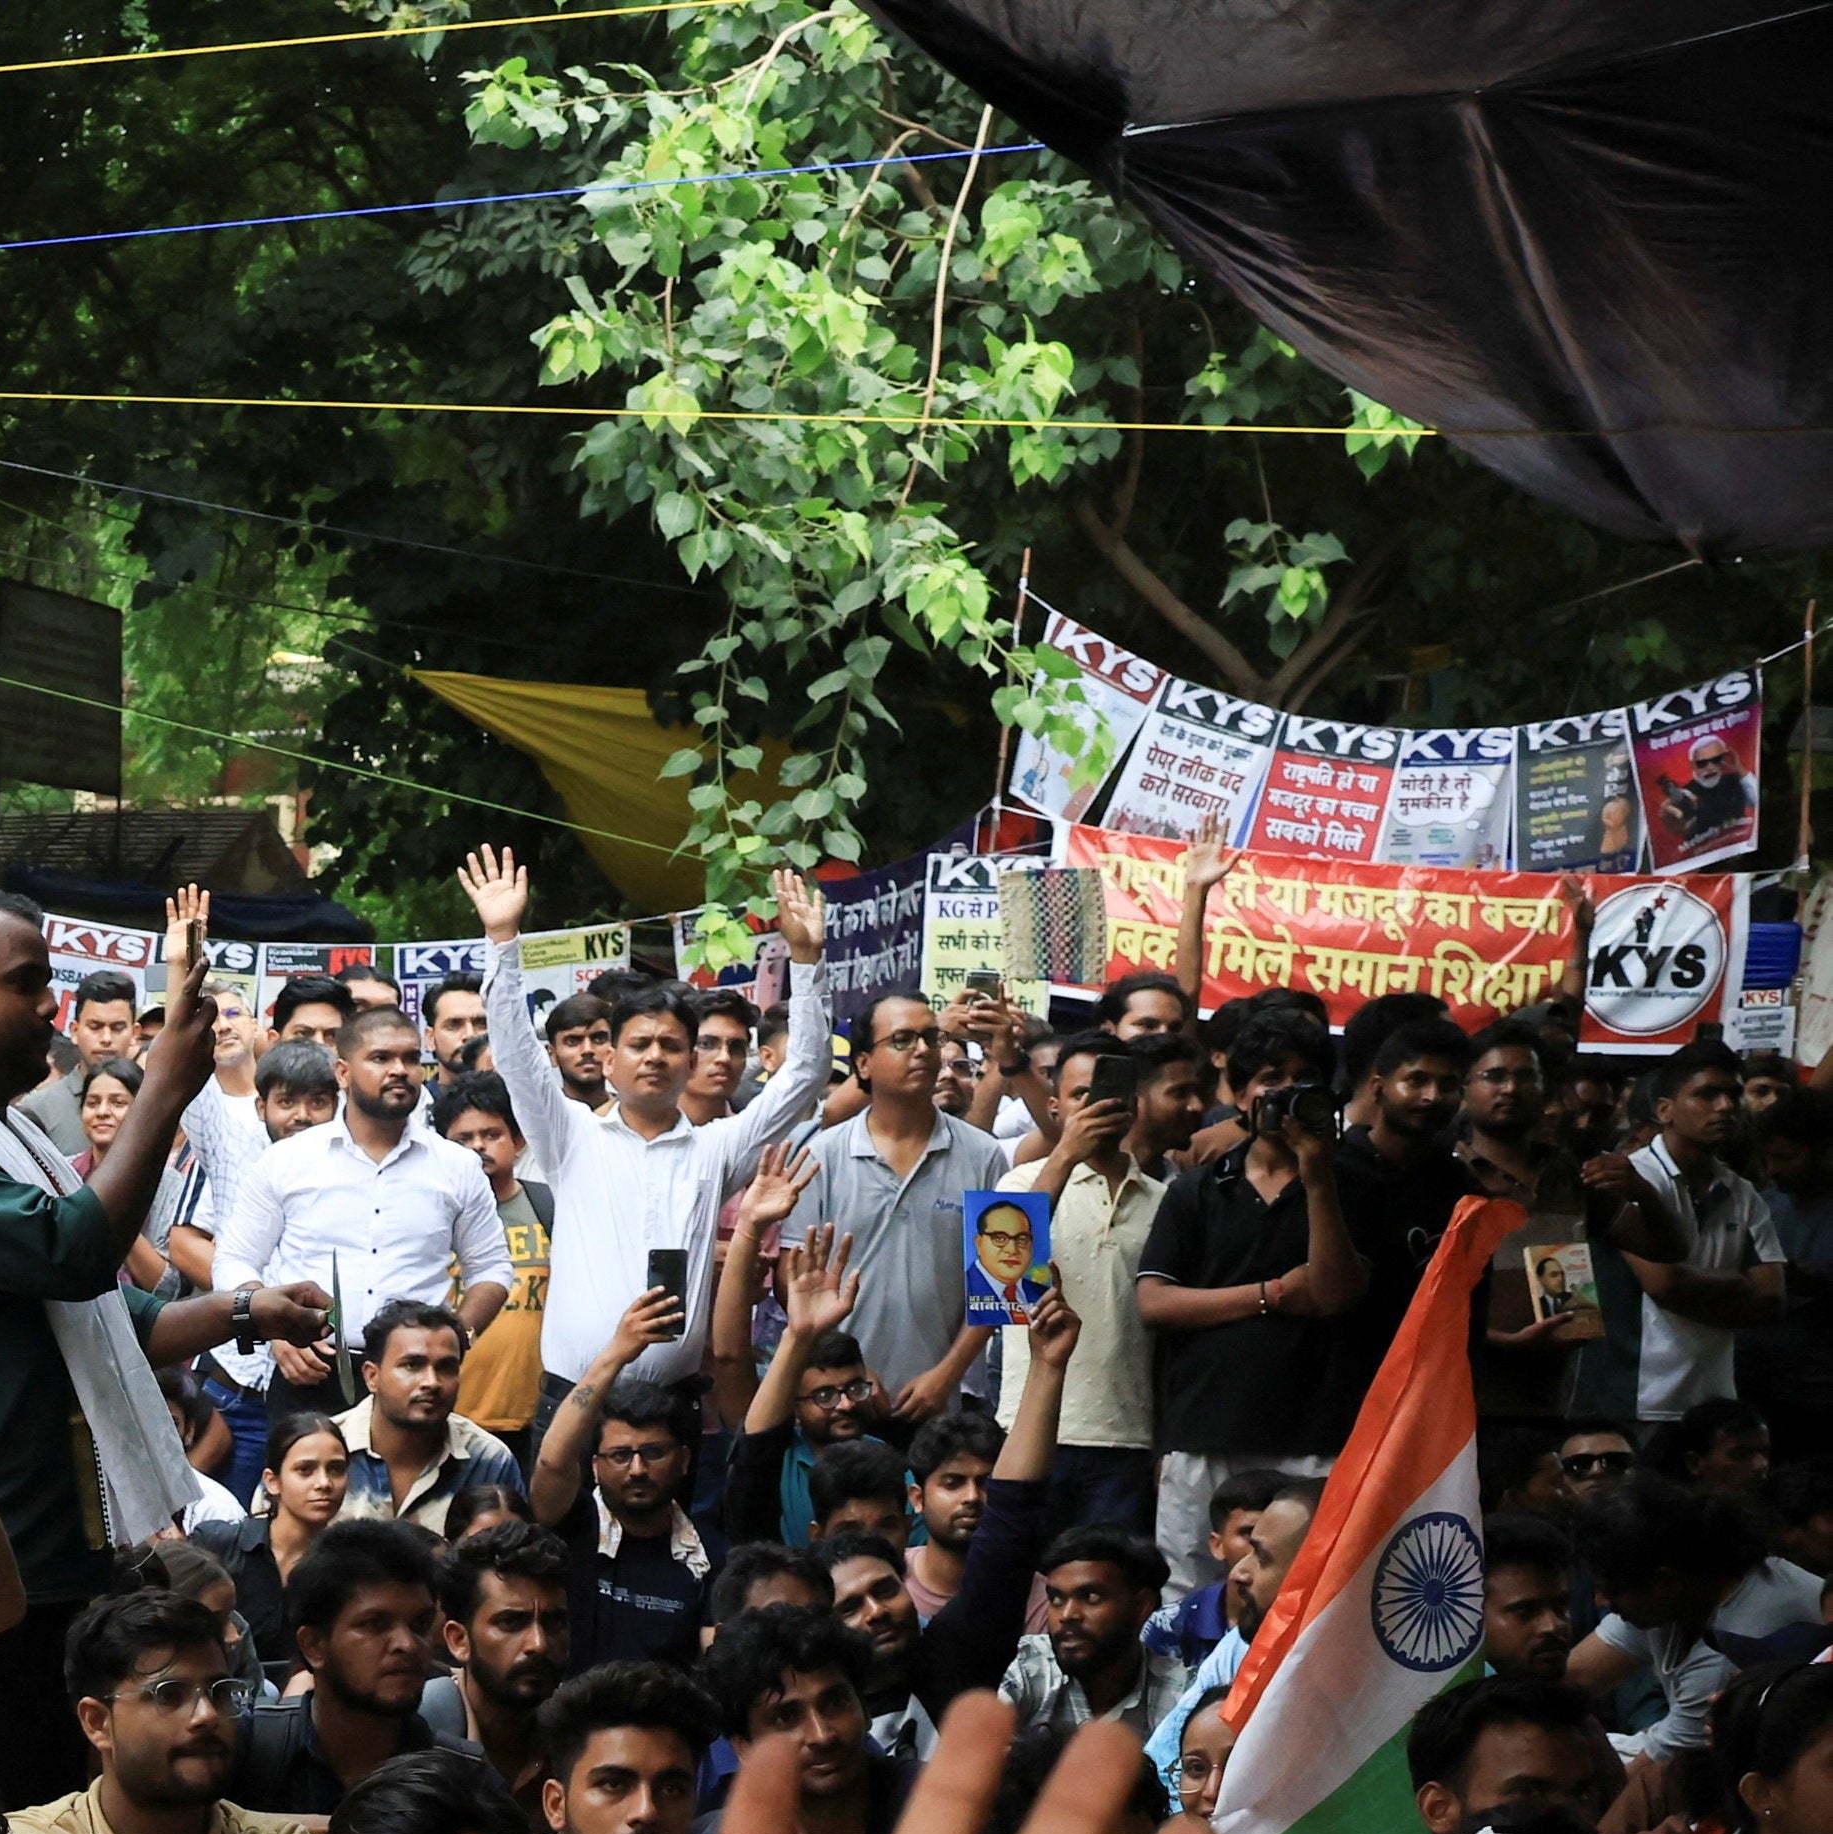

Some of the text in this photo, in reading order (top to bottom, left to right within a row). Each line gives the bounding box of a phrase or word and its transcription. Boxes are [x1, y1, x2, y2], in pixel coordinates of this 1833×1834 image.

[1053, 619, 1159, 692] KYS
[1165, 680, 1275, 737] KYS
[1633, 672, 1752, 733] KYS
[1284, 716, 1397, 760] KYS
[1403, 727, 1513, 759] KYS
[1528, 709, 1624, 750] KYS
[1146, 741, 1246, 796] पेपर लीक बंद
[1282, 761, 1380, 793] राष्ट्रपति हो या
[1400, 773, 1473, 792] मोदी है तो
[1139, 772, 1230, 816] करो सरकार!
[1268, 788, 1381, 822] मजदूर का बच्चा
[1459, 791, 1470, 811] है
[1265, 817, 1323, 846] सबको
[1322, 820, 1366, 853] मिले
[938, 900, 965, 918] KG
[969, 897, 983, 919] से
[1223, 860, 1567, 943] हो या मजदूर का बच्चा
[50, 919, 147, 961] KYS
[203, 942, 254, 970] YS
[584, 930, 624, 961] KYS
[937, 928, 990, 951] सभी को
[1205, 914, 1301, 986] मिले
[1304, 943, 1425, 996] समान
[405, 945, 486, 974] KYS
[1590, 944, 1707, 988] KYS
[1745, 991, 1780, 1004] KYS
